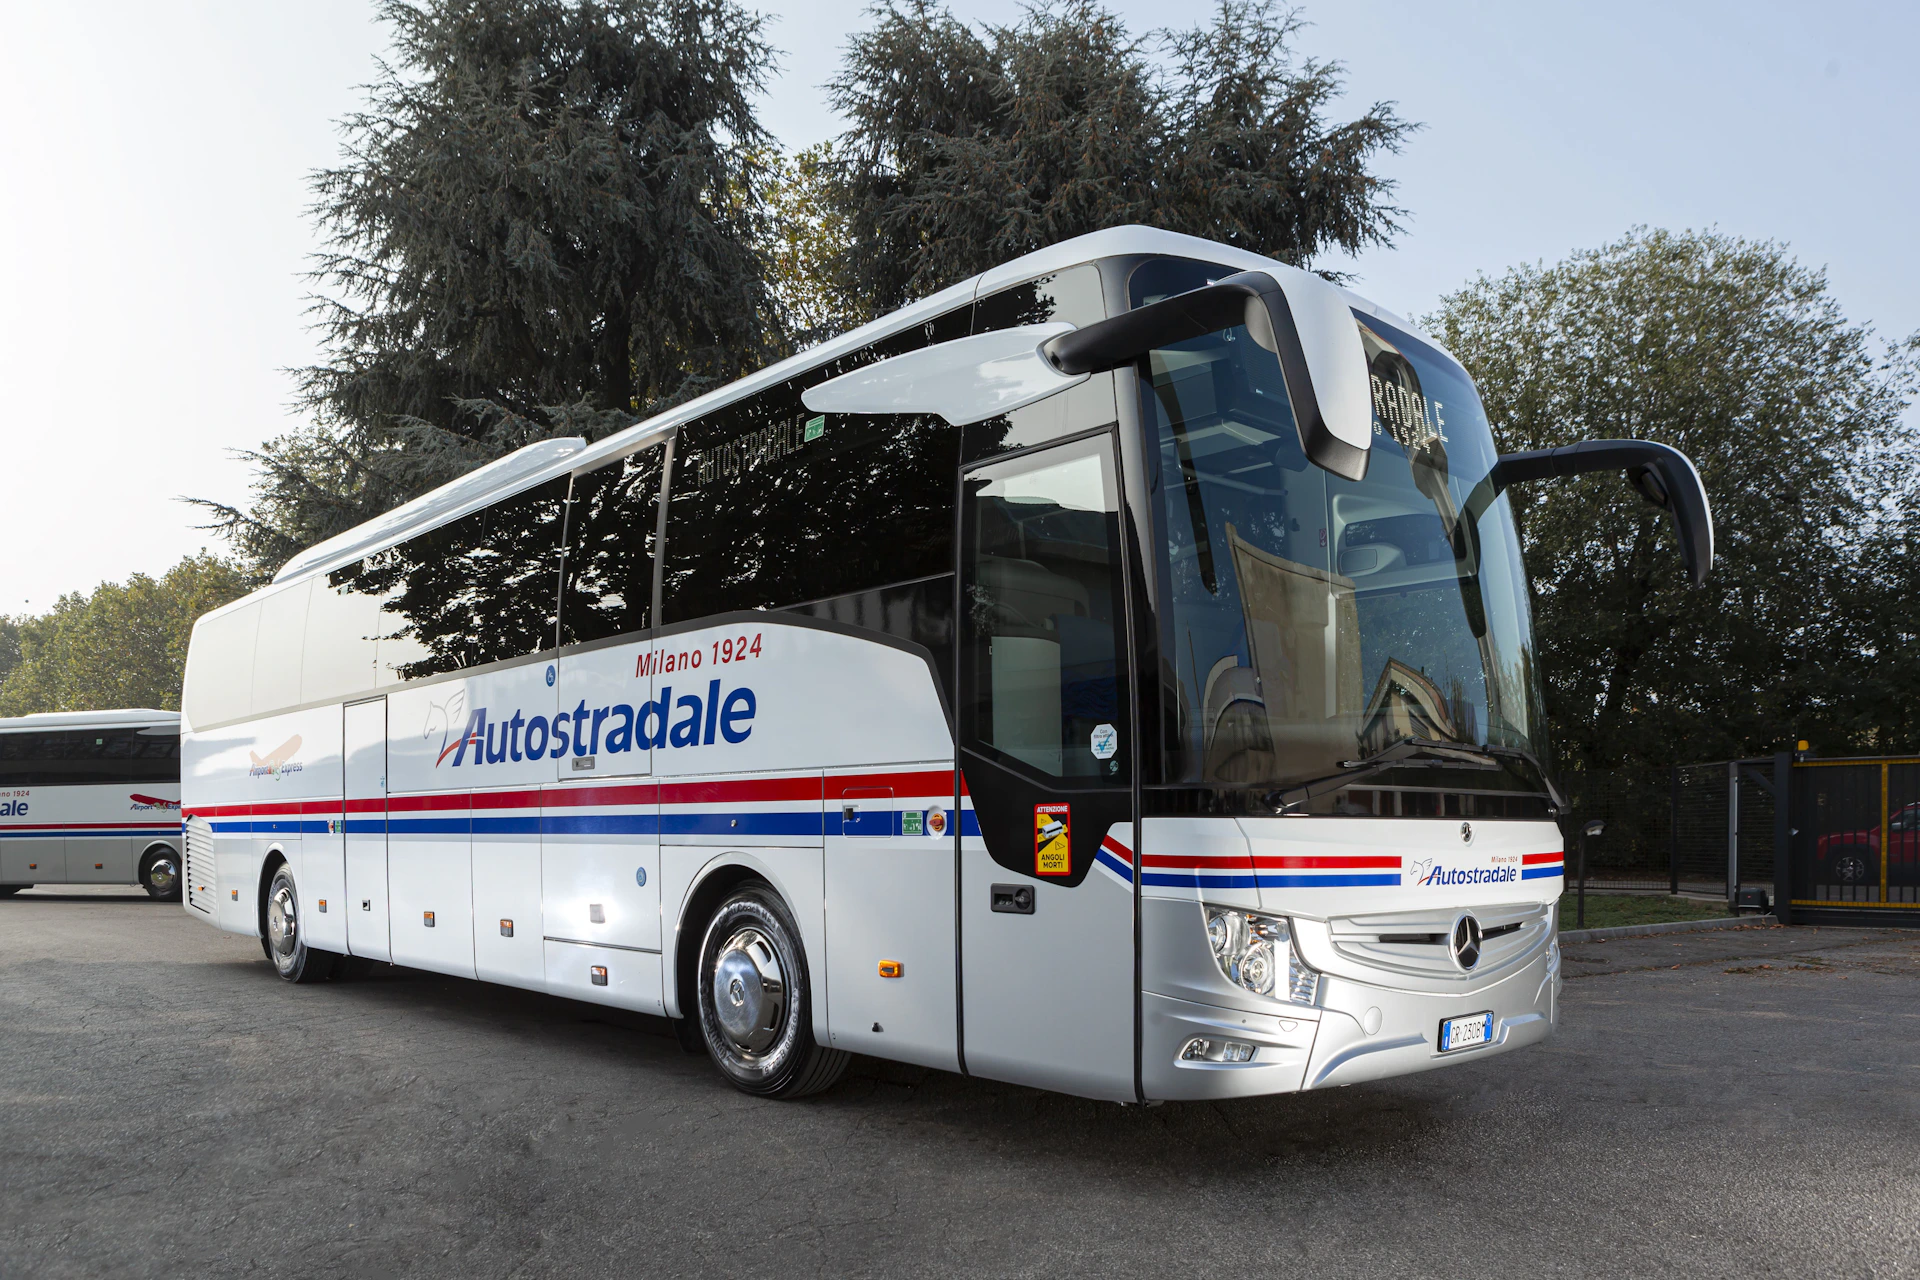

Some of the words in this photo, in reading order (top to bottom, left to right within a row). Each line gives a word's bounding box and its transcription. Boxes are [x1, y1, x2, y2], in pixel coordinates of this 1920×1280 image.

[697, 412, 805, 487] AUTOSTRADALE
[635, 648, 703, 678] Milano
[712, 632, 763, 666] 1924
[450, 678, 757, 768] Autostradale
[281, 761, 303, 777] Express
[130, 803, 153, 812] Airport
[1036, 805, 1068, 813] ATTENZIONE
[1041, 853, 1065, 861] ANGOLI
[1042, 861, 1063, 869] MORTI
[1425, 865, 1517, 886] Autostradale
